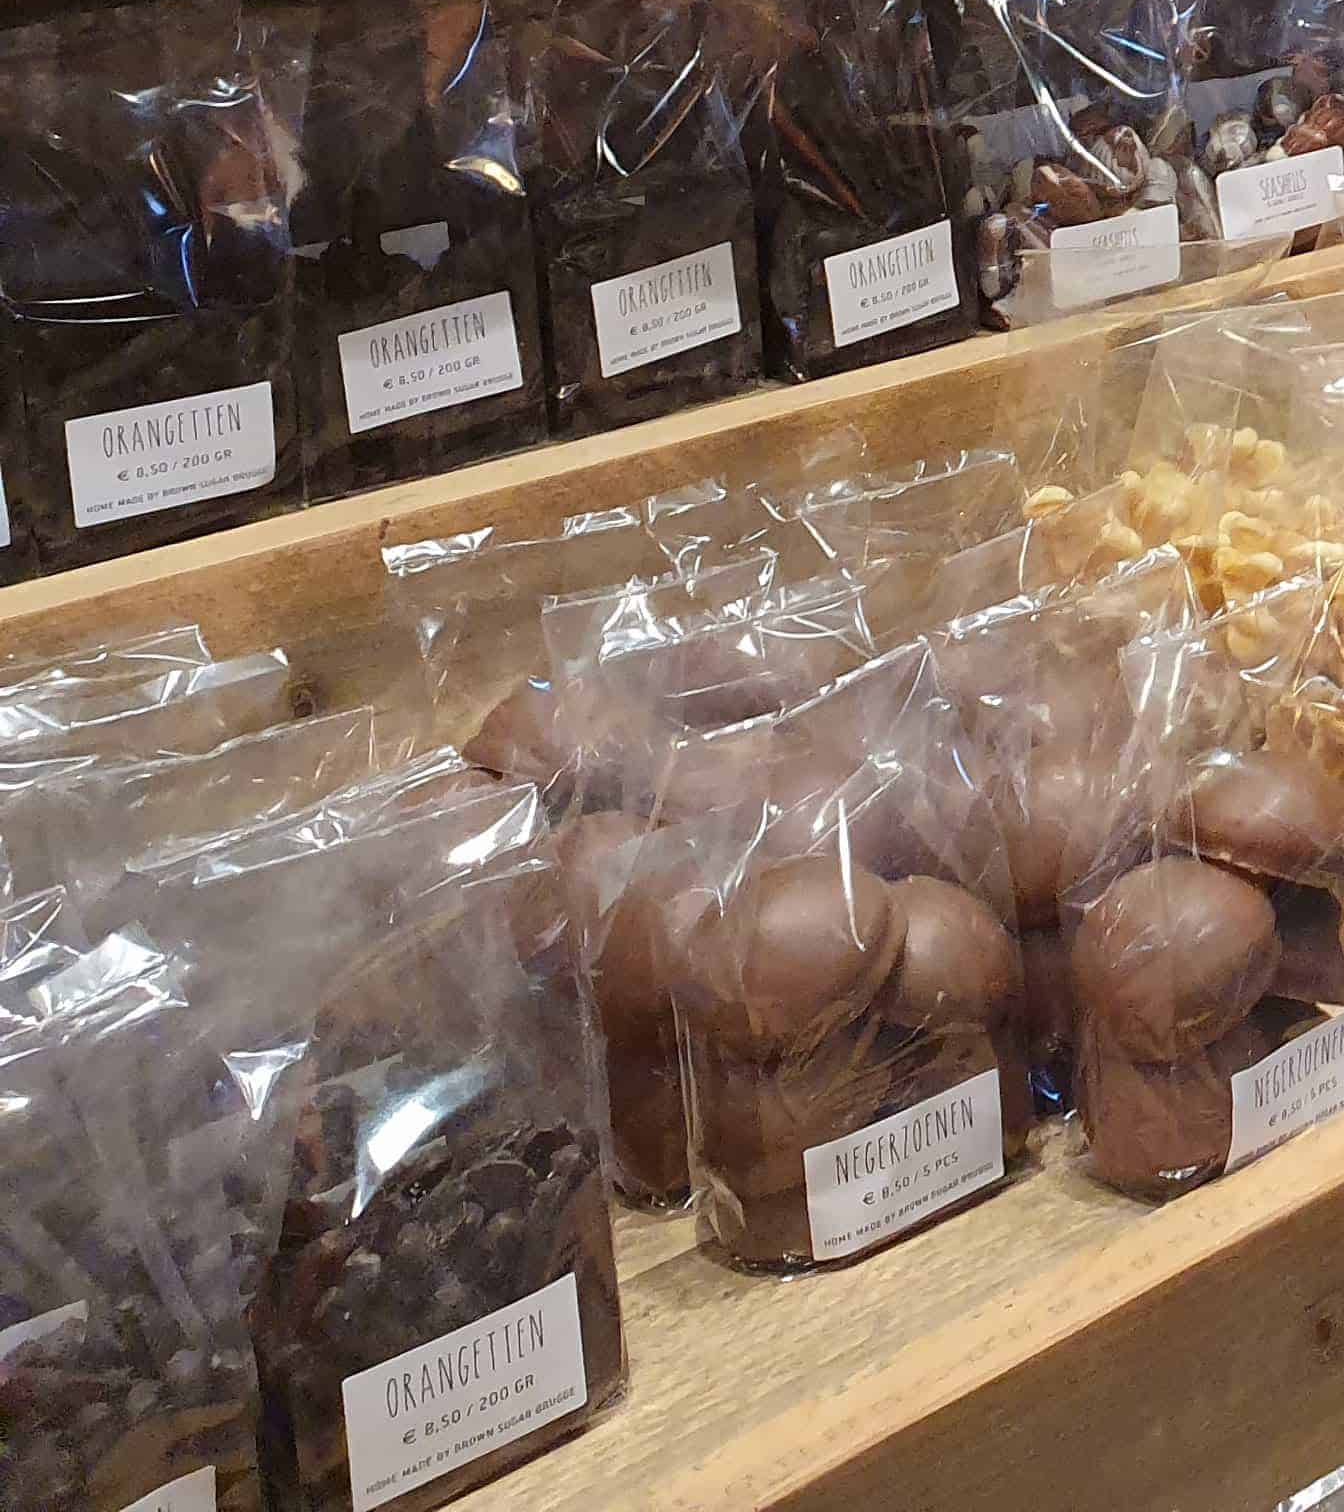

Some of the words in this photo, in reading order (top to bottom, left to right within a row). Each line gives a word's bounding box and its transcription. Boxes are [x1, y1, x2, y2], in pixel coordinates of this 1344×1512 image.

[618, 261, 713, 319] ORANGETTEN
[849, 239, 934, 290] ORANGETTEN
[370, 311, 486, 370] ORANGETTEN
[383, 378, 394, 391] €
[438, 359, 461, 376] 200
[465, 355, 481, 370] GR
[103, 402, 242, 460] ORANGETTEN
[117, 470, 130, 482] €
[183, 453, 210, 471] 200
[214, 448, 232, 463] GR
[834, 1096, 974, 1186] NEGERZOENEN
[861, 1191, 876, 1206] €
[923, 1163, 931, 1178] 5
[935, 1151, 959, 1172] PCS
[386, 1309, 544, 1419] ORANGETTEN
[402, 1428, 418, 1446] €
[424, 1408, 462, 1442] 8.50
[479, 1385, 510, 1413] 200
[514, 1373, 536, 1396] GR
[366, 1474, 397, 1495] HOME
[402, 1456, 433, 1478] MADE
[437, 1447, 451, 1463] BY
[454, 1430, 495, 1456] BROWN
[496, 1413, 533, 1438] SUGAR
